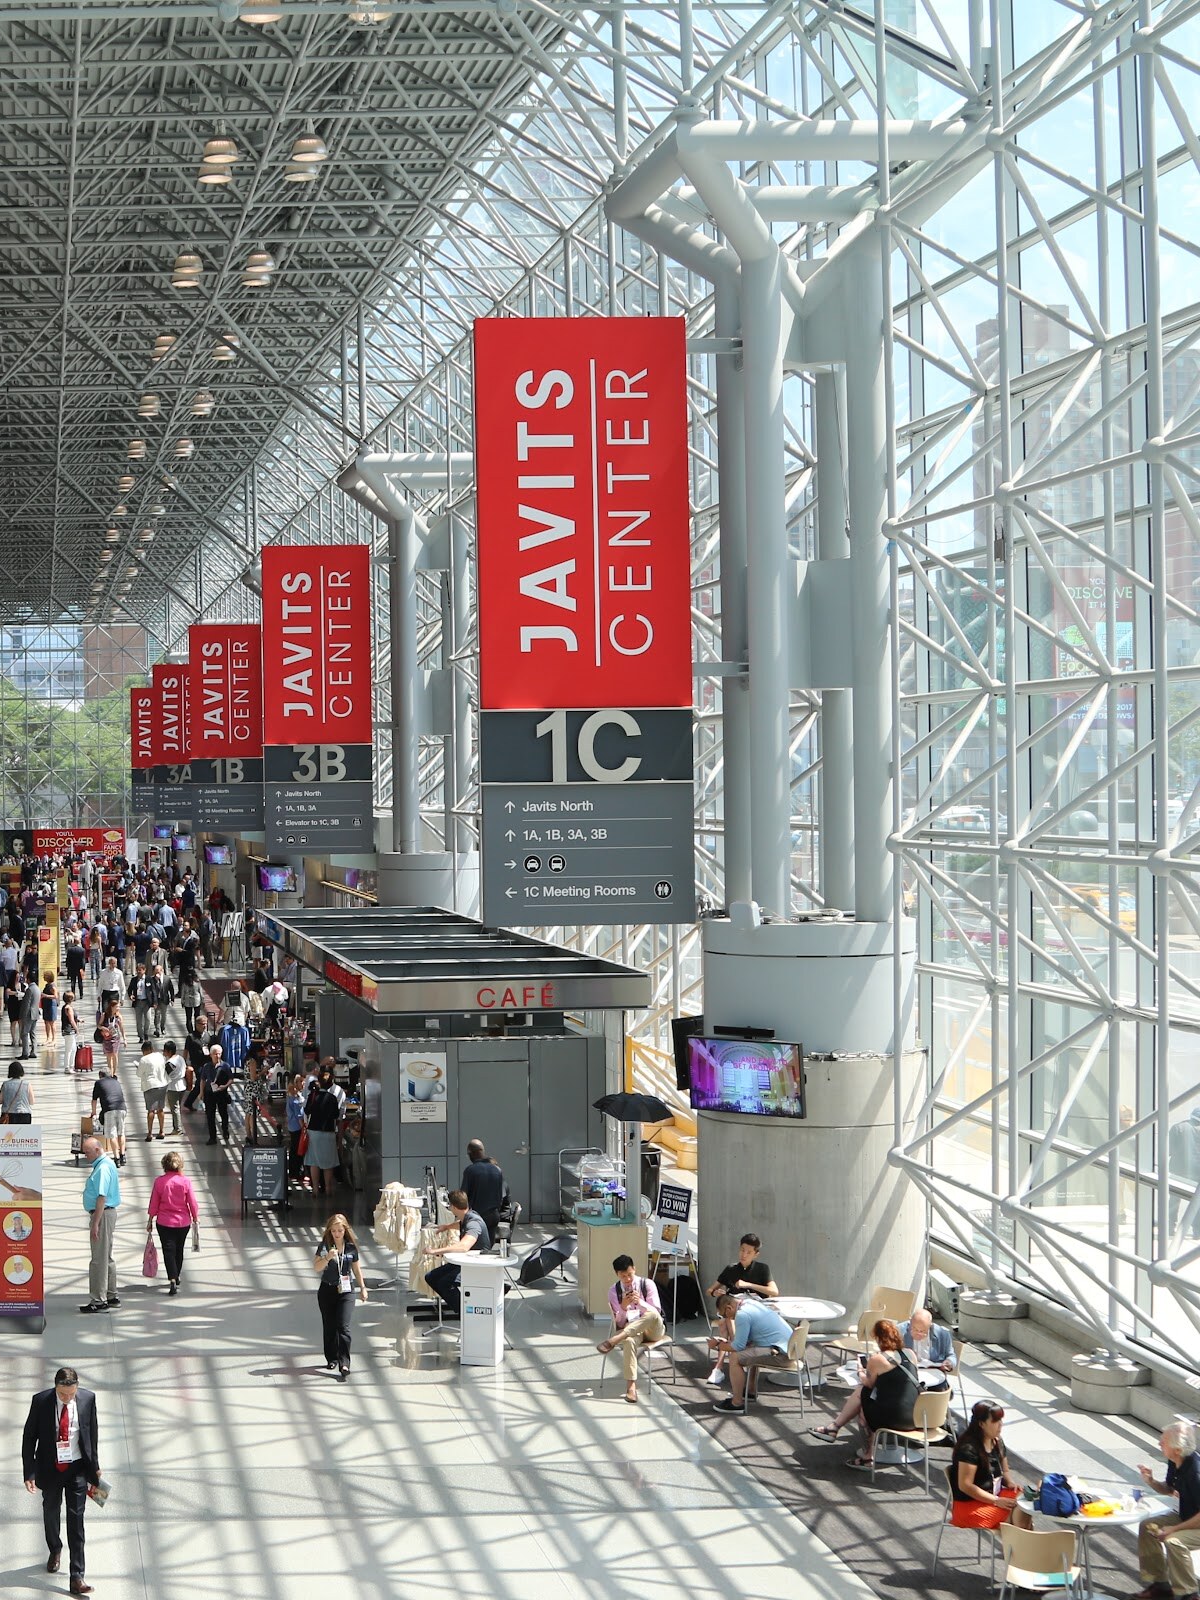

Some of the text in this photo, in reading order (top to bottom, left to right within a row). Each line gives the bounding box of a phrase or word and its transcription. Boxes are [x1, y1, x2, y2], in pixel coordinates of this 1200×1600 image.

[515, 368, 578, 654] JAVITS
[604, 367, 654, 657] CENTER
[282, 571, 313, 718] JAVITS
[327, 570, 353, 718] CENTER
[162, 676, 179, 751] JAVITS
[202, 641, 224, 740] JAVITS
[232, 640, 250, 740] CENTER
[138, 698, 152, 758] JAVITS
[536, 710, 643, 783] 1C
[142, 768, 154, 784] 1
[166, 765, 192, 784] 3A
[210, 758, 244, 784] 1B
[292, 744, 347, 782] 3B
[522, 800, 594, 812] Javits North
[523, 828, 608, 842] 1A, 1B, 3A, 3B
[524, 885, 636, 899] 1C Meeting Rooms
[476, 983, 558, 1008] CAFÉ
[662, 1198, 687, 1212] TO WIN
